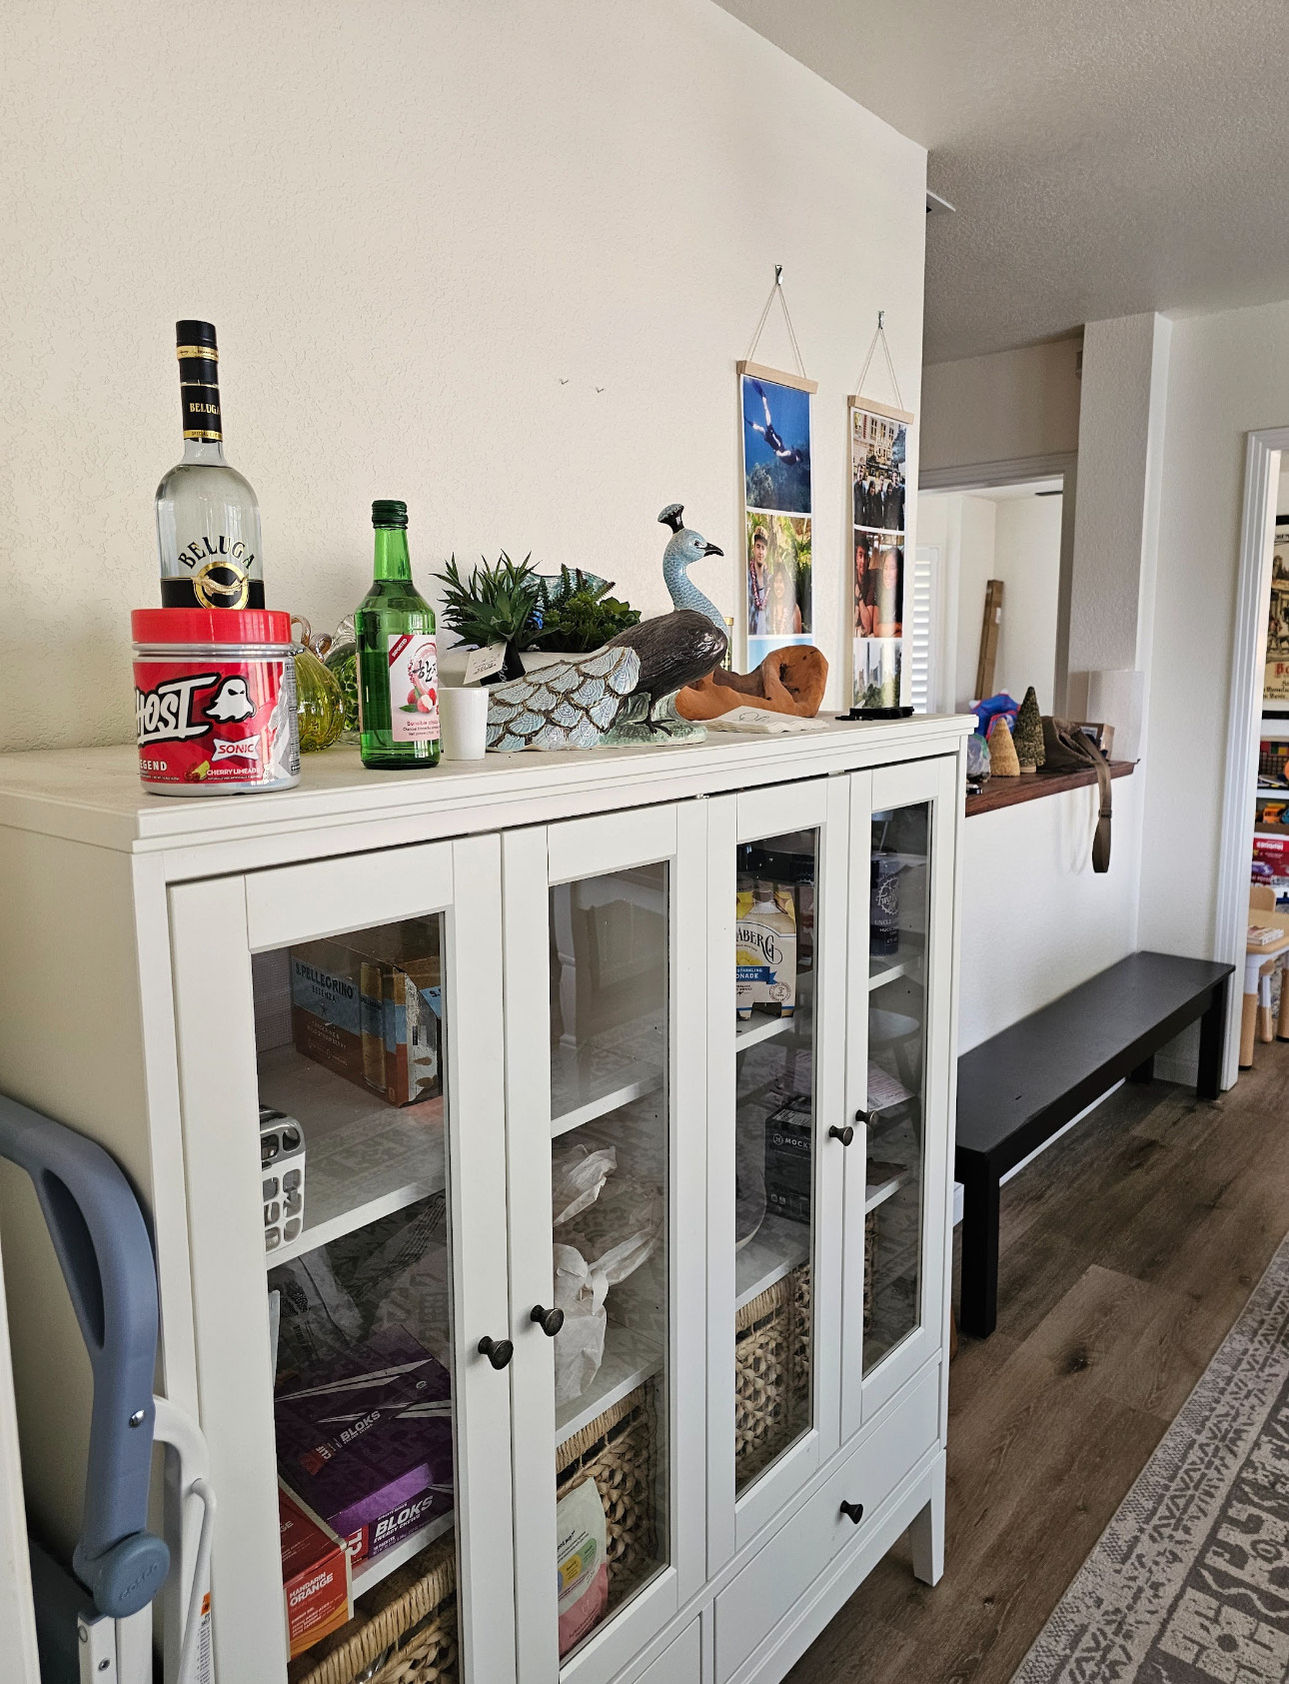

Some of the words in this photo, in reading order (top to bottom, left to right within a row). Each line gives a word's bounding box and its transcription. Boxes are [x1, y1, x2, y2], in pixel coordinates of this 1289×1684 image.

[178, 535, 255, 570] BELUGA
[135, 674, 219, 744] HOST
[139, 760, 168, 771] EGEND
[218, 743, 255, 755] SONIC
[736, 926, 784, 965] ABERG
[339, 1410, 381, 1443] BLOKS
[375, 1495, 434, 1538] BLOKS
[289, 1571, 327, 1599] MANDARIN
[289, 1573, 334, 1607] ORANGE
